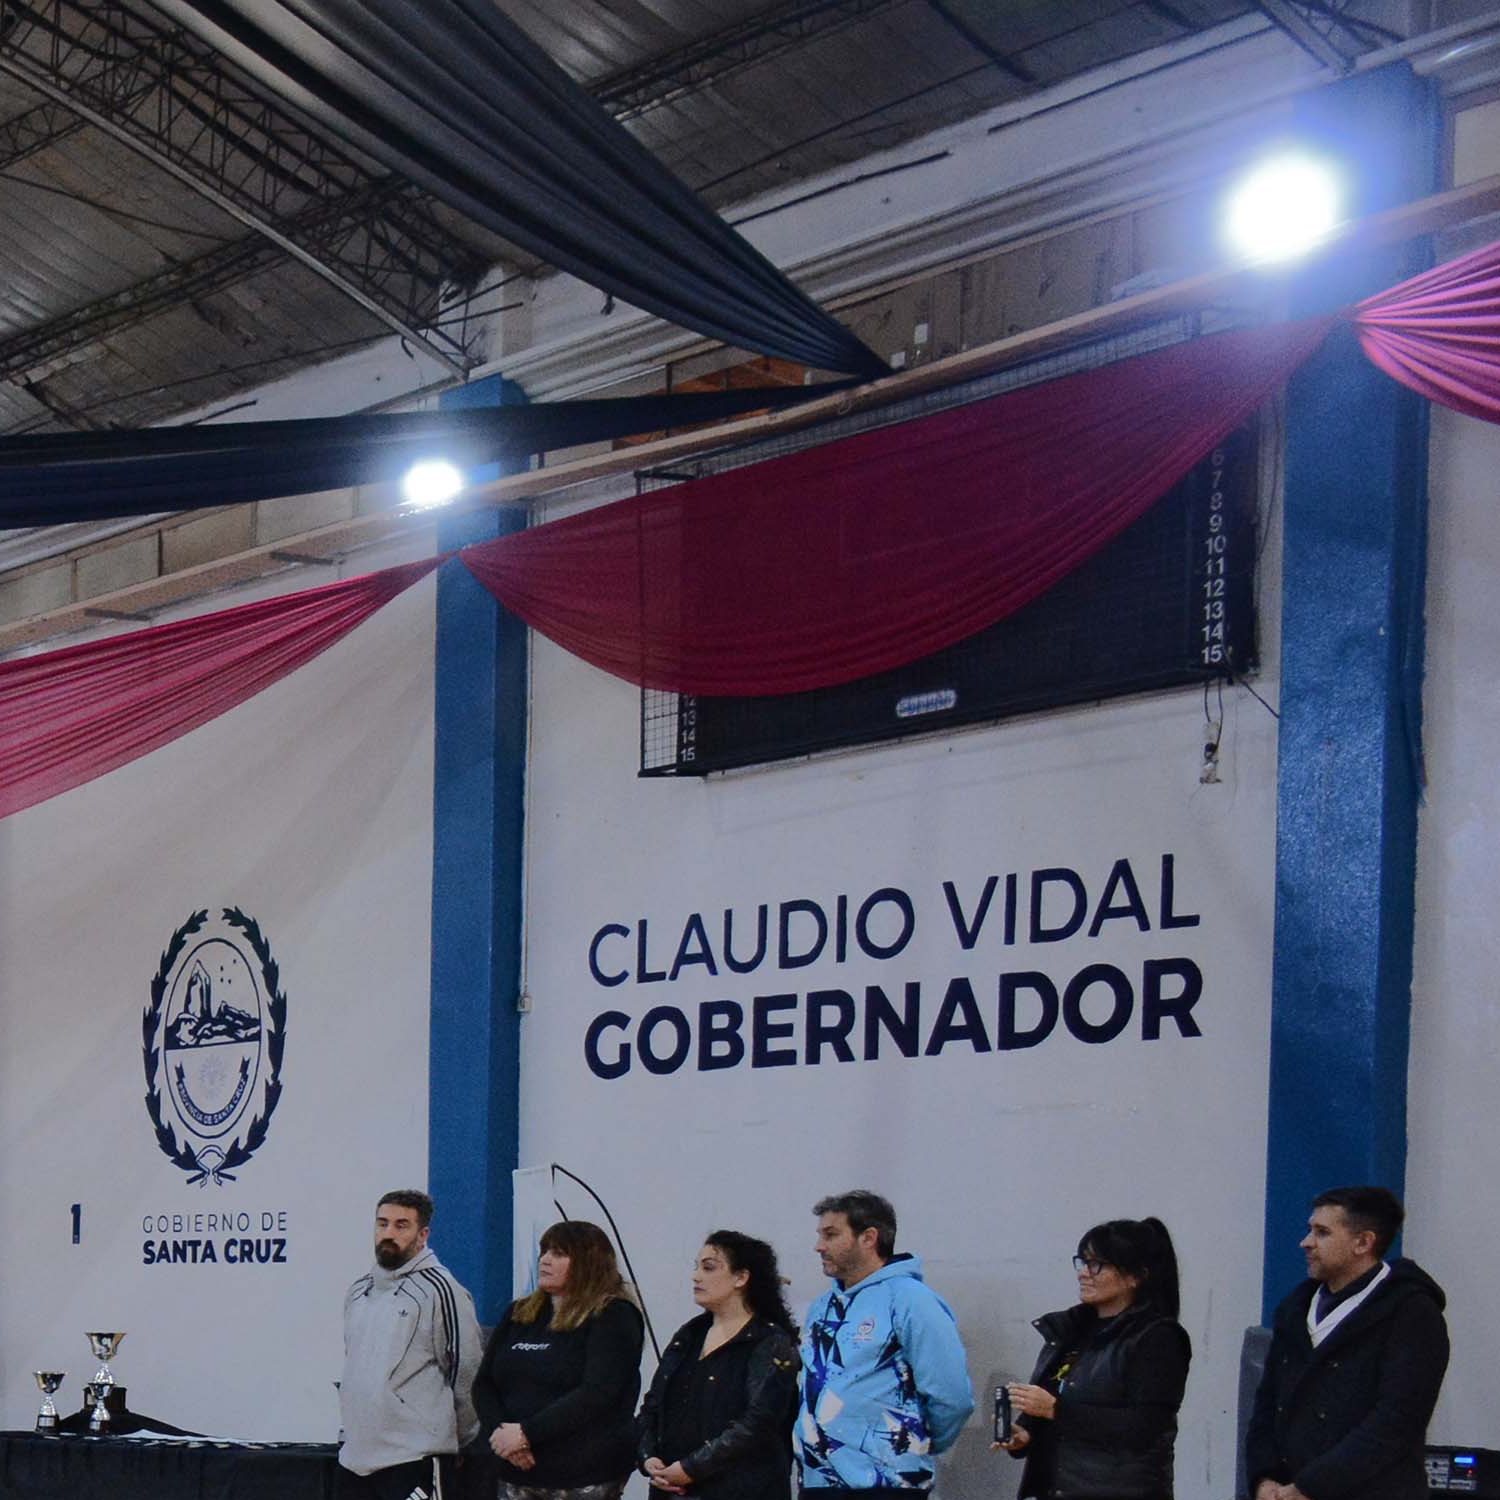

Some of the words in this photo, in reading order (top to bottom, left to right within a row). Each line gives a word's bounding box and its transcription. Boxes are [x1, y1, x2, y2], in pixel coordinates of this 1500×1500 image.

[1212, 471, 1223, 489] 7
[1210, 492, 1222, 510] 8
[1209, 515, 1223, 532] 9
[1205, 535, 1226, 554] 10
[1205, 557, 1225, 575] 11
[1203, 578, 1225, 598] 12
[1203, 601, 1224, 621] 13
[1202, 622, 1224, 642] 14
[1201, 645, 1223, 664] 15
[682, 711, 696, 727] 13
[681, 728, 695, 744] 14
[680, 747, 695, 762] 15
[588, 887, 916, 988] CLAUDIO
[942, 853, 1201, 950] VIDAL
[584, 957, 1204, 1080] GOBERNADOR
[142, 1212, 249, 1233] GOBIERNO
[261, 1211, 287, 1231] DE
[142, 1239, 217, 1264] SANTA
[224, 1238, 287, 1263] CRUZ
